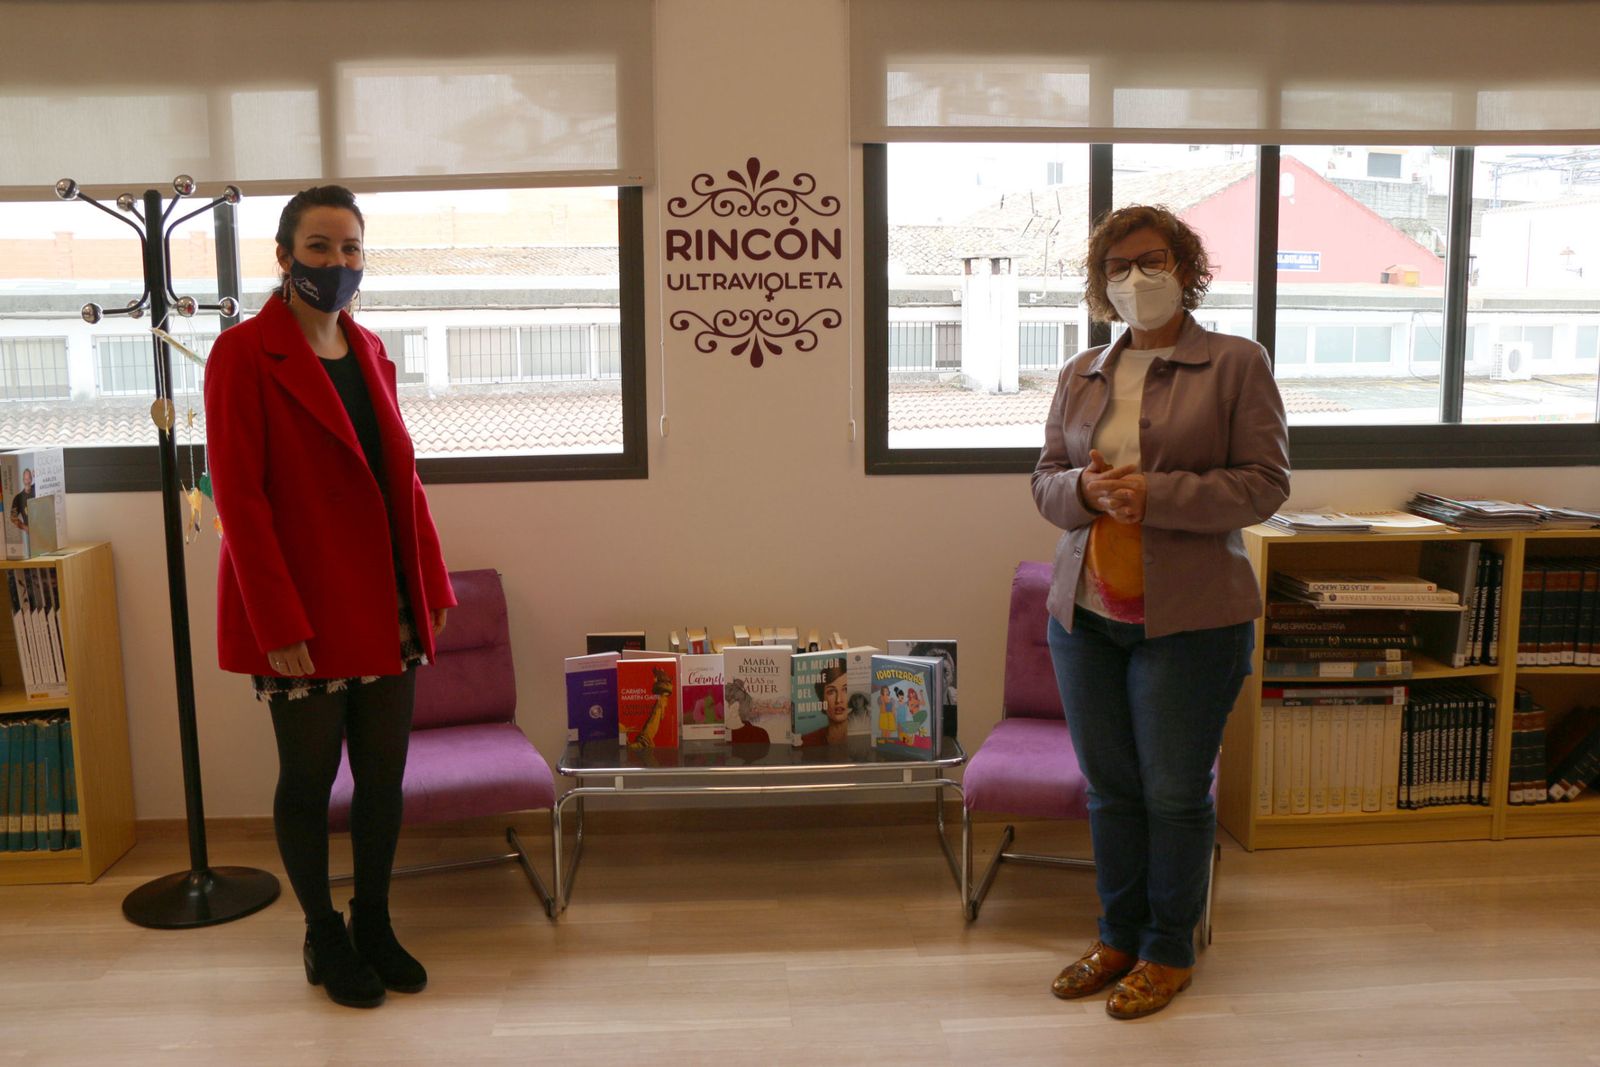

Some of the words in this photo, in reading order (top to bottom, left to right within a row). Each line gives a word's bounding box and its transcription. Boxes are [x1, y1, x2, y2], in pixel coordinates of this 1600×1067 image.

[666, 216, 842, 261] RINCÓN
[667, 272, 843, 302] ULTRAVIOLETA
[738, 665, 780, 674] BENEDIT
[797, 661, 808, 672] LA
[811, 658, 840, 670] MEJOR
[688, 671, 725, 686] Carmel
[744, 676, 765, 684] ALAS
[797, 672, 827, 685] MADRE
[875, 669, 924, 685] IDIOTIZADAS
[798, 688, 811, 700] DEL
[797, 700, 829, 713] MUNDO
